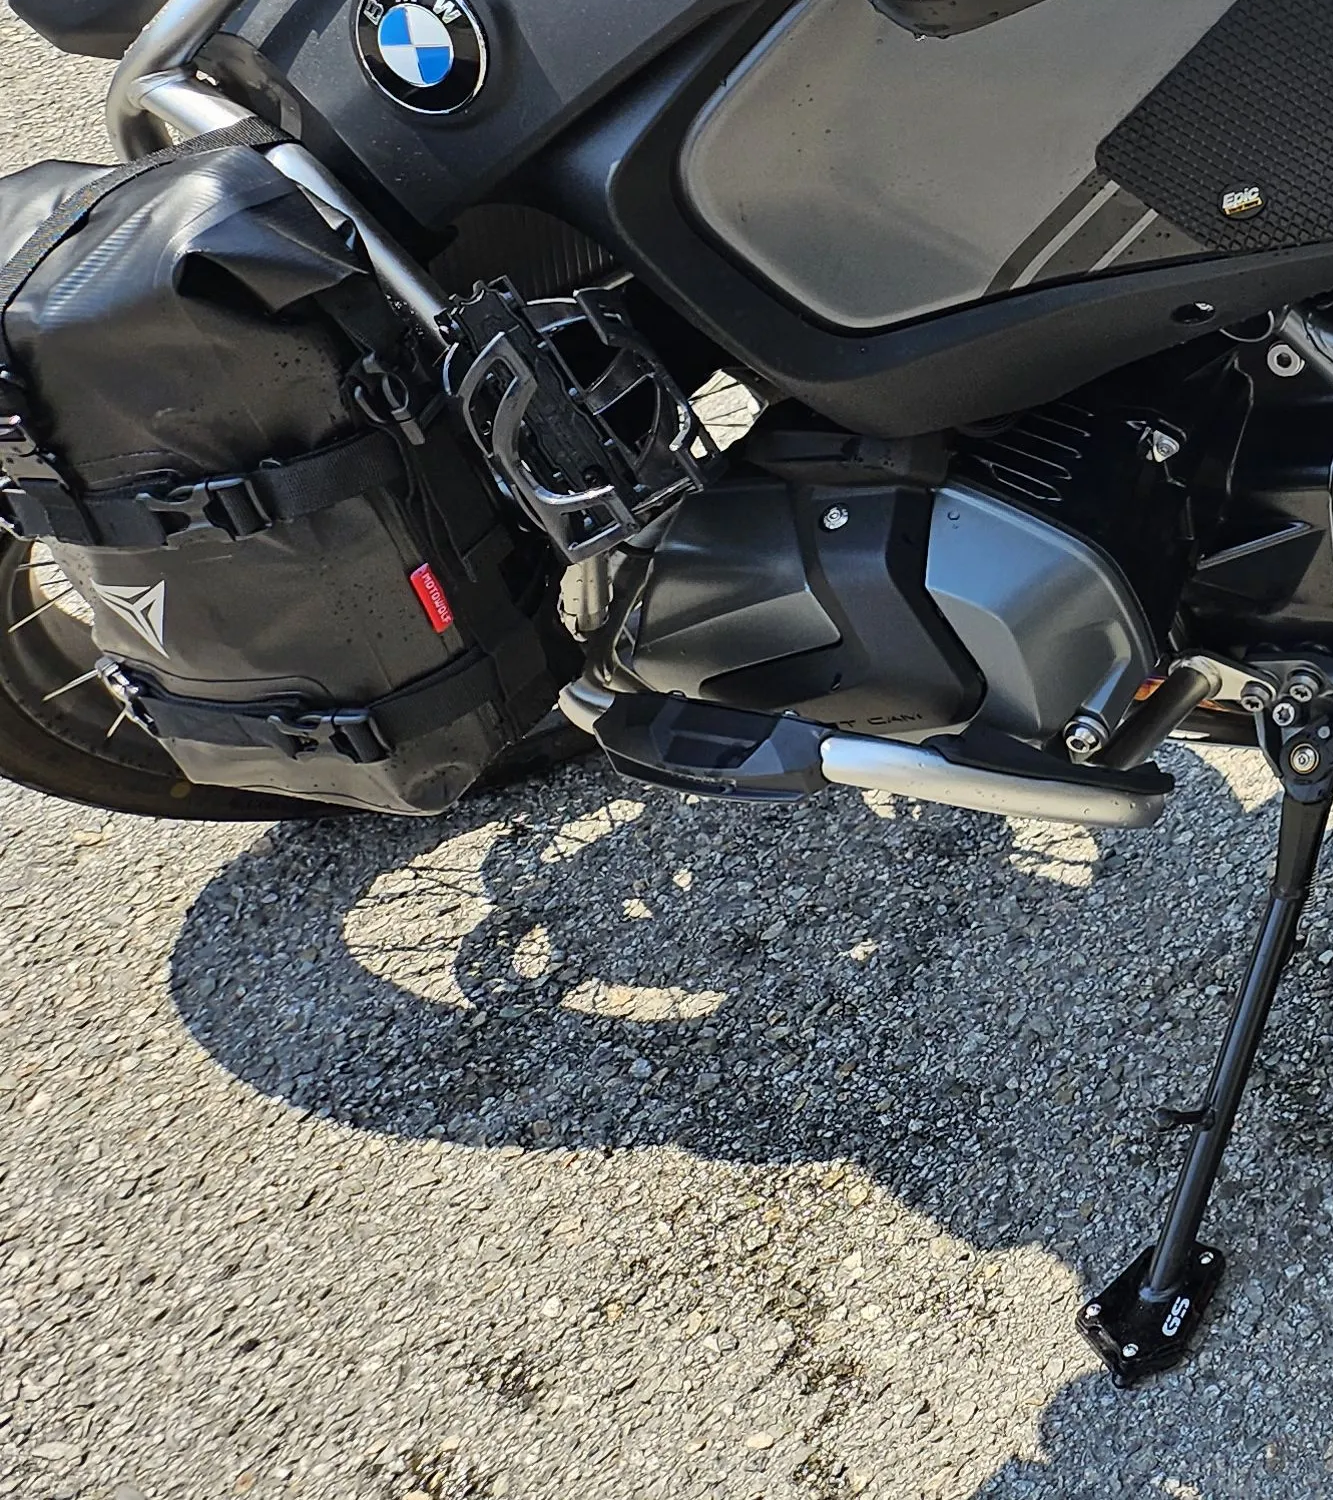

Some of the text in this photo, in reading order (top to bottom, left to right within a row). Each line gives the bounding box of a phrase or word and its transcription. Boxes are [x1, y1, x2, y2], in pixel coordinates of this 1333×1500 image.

[1222, 186, 1260, 209] Epic
[421, 572, 452, 623] MOTOWOLF
[1161, 1296, 1191, 1338] GS
